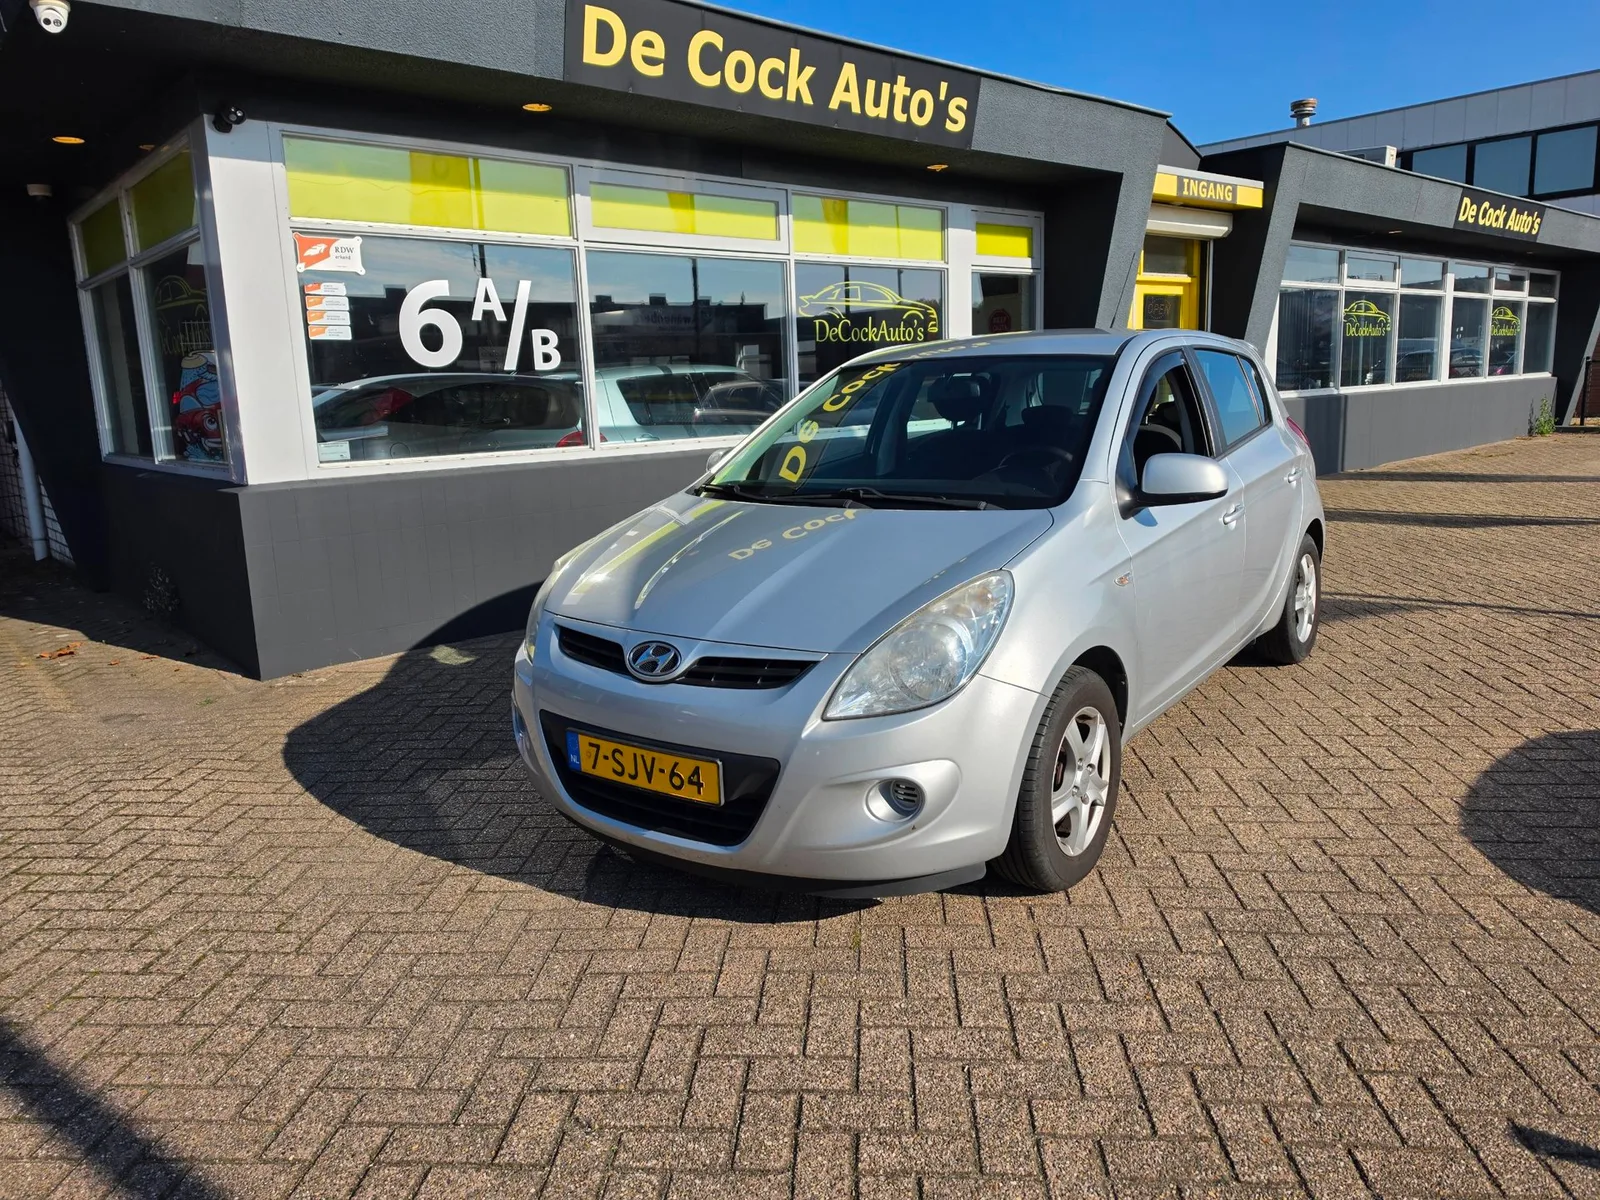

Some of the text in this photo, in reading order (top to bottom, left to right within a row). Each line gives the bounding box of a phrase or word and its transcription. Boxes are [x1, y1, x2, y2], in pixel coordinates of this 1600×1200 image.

[582, 4, 968, 132] De Cock Auto's
[1183, 178, 1233, 201] INGANG
[1458, 196, 1541, 235] De Cock Auto's
[813, 315, 925, 342] DeCockAuto's
[1345, 322, 1386, 337] DeCockAuto's
[570, 754, 580, 765] NL
[588, 742, 706, 796] 7-SJV-64
